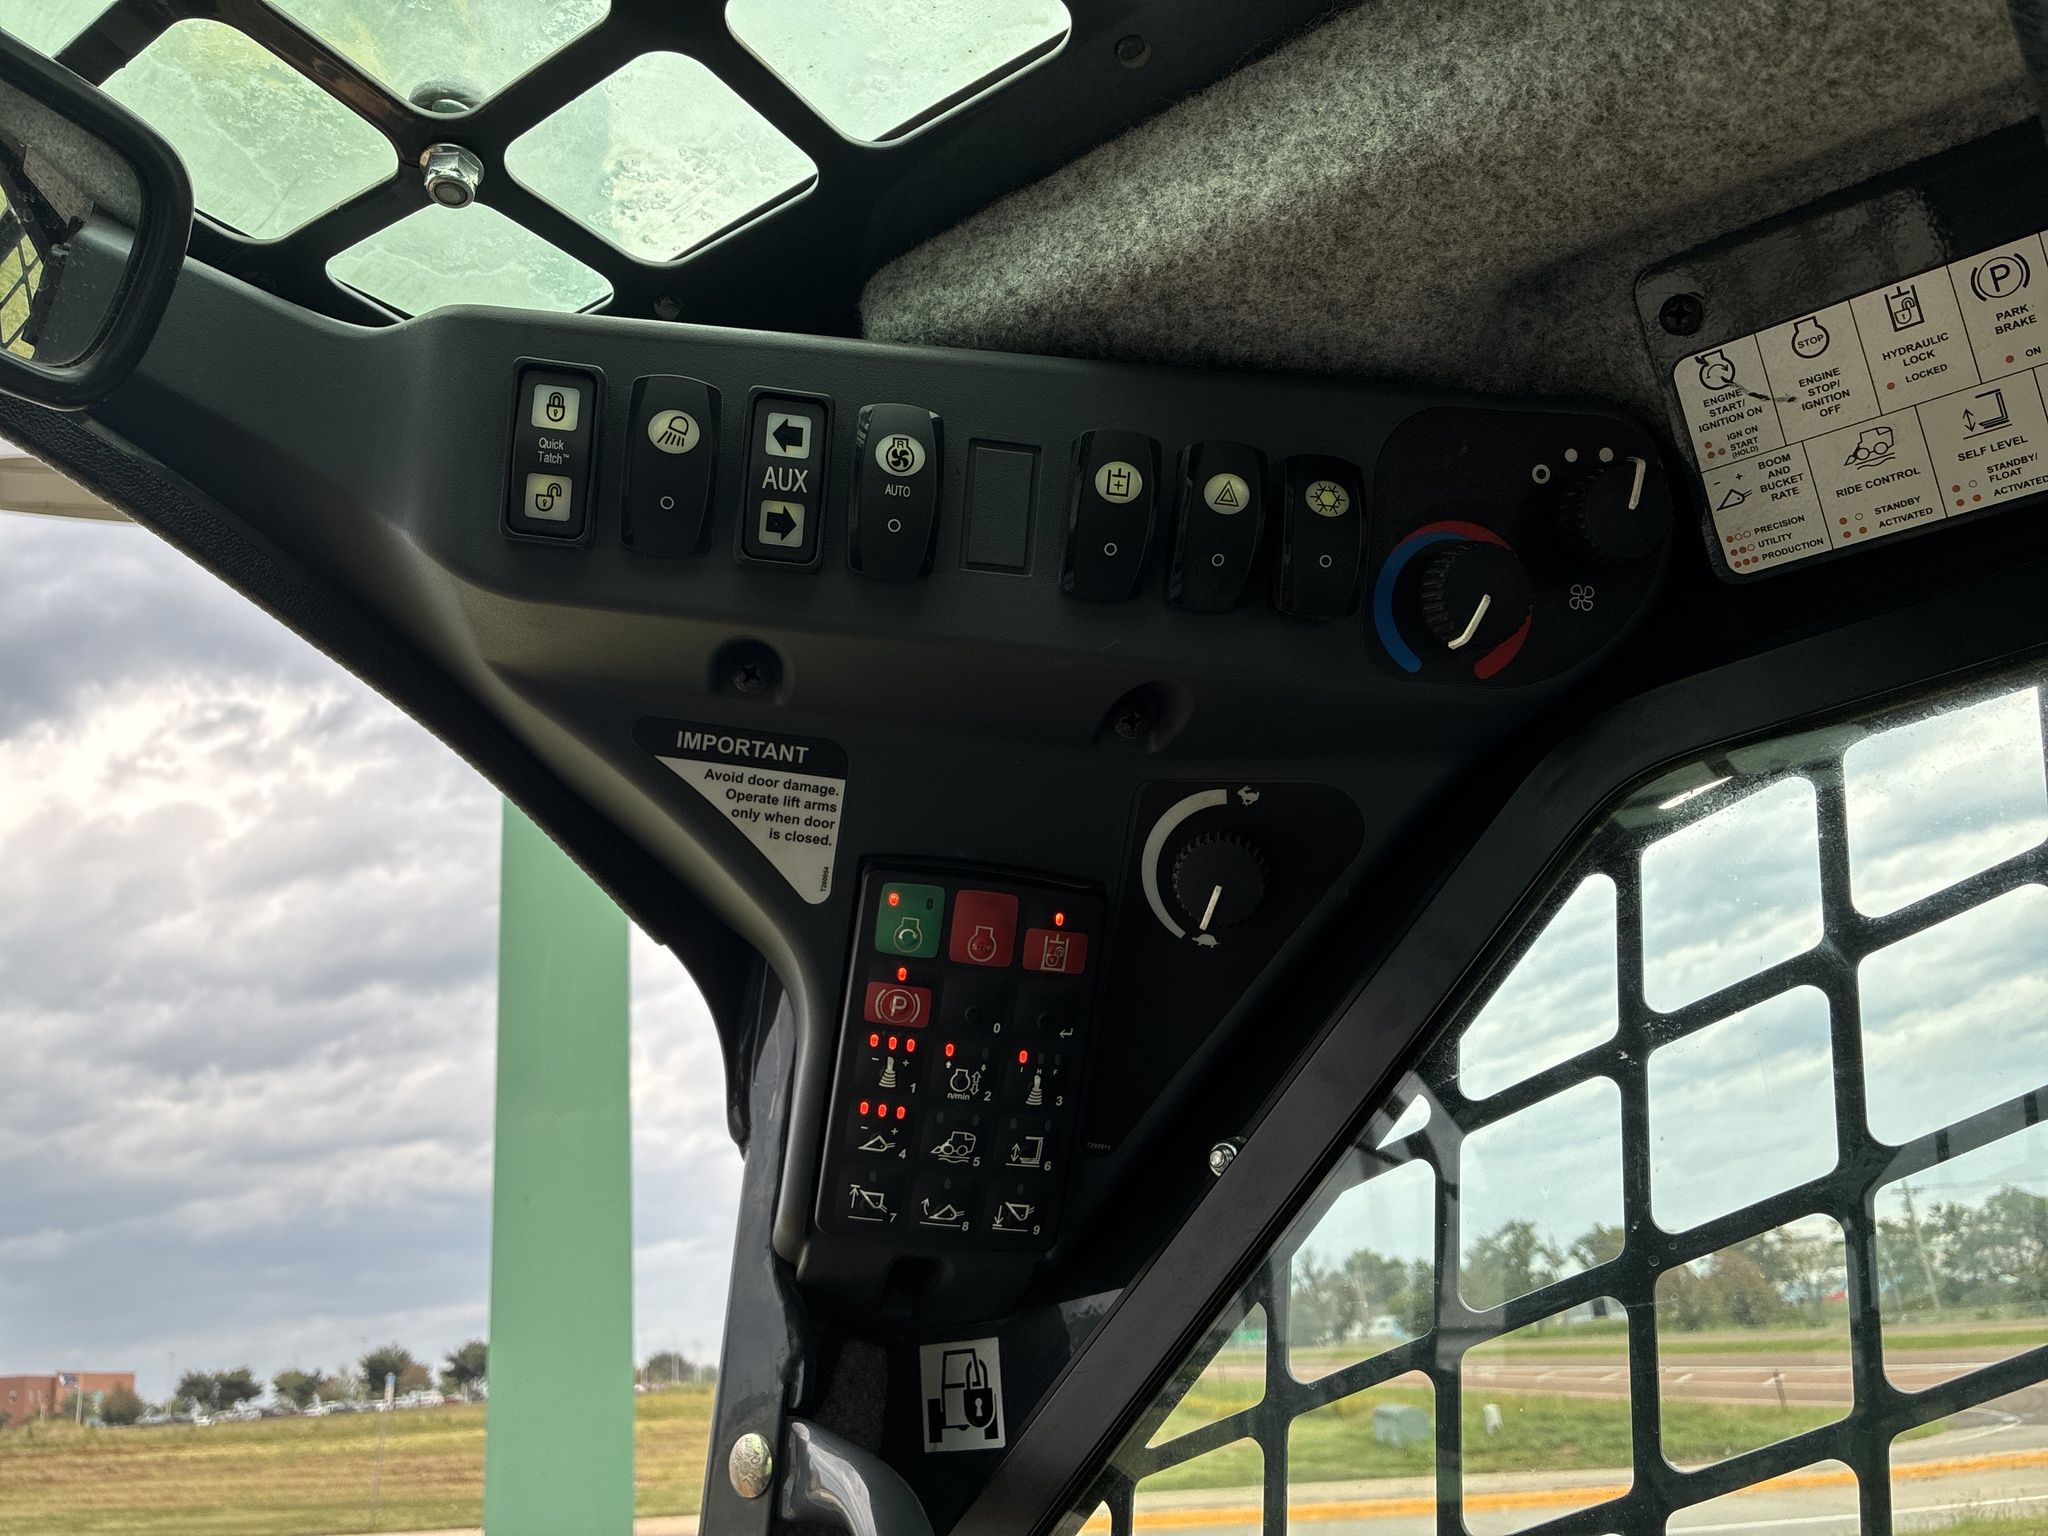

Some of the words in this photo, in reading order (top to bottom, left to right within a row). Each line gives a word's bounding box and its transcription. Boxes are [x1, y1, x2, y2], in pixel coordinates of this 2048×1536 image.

[1995, 304, 2029, 321] PARK
[1994, 314, 2037, 335] BRAKE
[1797, 334, 1824, 349] STOP
[1882, 332, 1949, 361] HYDRAULIC
[1902, 349, 1936, 367] LOCK
[2025, 346, 2041, 357] ON
[1798, 367, 1841, 388] ENGINE
[1905, 363, 1948, 383] LOCKED
[1808, 379, 1840, 397] STOP/
[1703, 388, 1743, 408] ENGINE
[1801, 389, 1850, 411] IGNITION
[1709, 398, 1745, 418] START/
[1819, 404, 1841, 417] OFF
[1698, 413, 1744, 433] IGNITION
[1747, 406, 1763, 418] ON
[1726, 431, 1742, 441] IGN
[1744, 425, 1758, 435] ON
[538, 437, 565, 451] Quick
[1730, 436, 1758, 451] START
[1731, 446, 1759, 459] (HOLD)
[1957, 446, 1987, 462] SELF
[1990, 435, 2028, 452] LEVEL
[1757, 453, 1791, 470] BOOM
[1986, 452, 2038, 474] STANDBY/
[761, 466, 809, 494] AUX
[1767, 465, 1790, 479] AND
[1989, 467, 2022, 483] FLOAT
[884, 484, 911, 498] AUTO
[1760, 472, 1804, 493] BUCKET
[1835, 483, 1863, 498] RIDE
[1865, 467, 1921, 489] CONTROL
[1993, 474, 2048, 497] ACTIVATED
[1771, 486, 1800, 501] RATE
[1874, 495, 1921, 515] STANDBY
[1754, 515, 1805, 535] PRECISION
[1878, 507, 1933, 528] ACTIVATED
[1758, 532, 1792, 548] UTILITY
[1761, 537, 1824, 560] PRODUCTION
[676, 730, 809, 764] IMPORTANT
[704, 768, 744, 784] Avoid
[748, 774, 780, 789] door
[783, 779, 840, 797] damage.
[725, 788, 779, 807] Operate
[783, 795, 801, 808] lift
[804, 801, 837, 813] arms
[731, 808, 761, 823] only
[765, 811, 800, 825] when
[804, 815, 836, 830] door
[769, 828, 781, 840] is
[784, 830, 833, 847] closed.
[909, 1082, 917, 1094] 1
[946, 1091, 971, 1101] n/min
[983, 1090, 992, 1102] 2
[1055, 1095, 1063, 1107] 3
[898, 1148, 907, 1160] 4
[972, 1156, 981, 1167] 5
[1043, 1161, 1052, 1172] 6
[888, 1212, 897, 1223] 7
[961, 1220, 970, 1232] 8
[1032, 1224, 1041, 1235] 9
